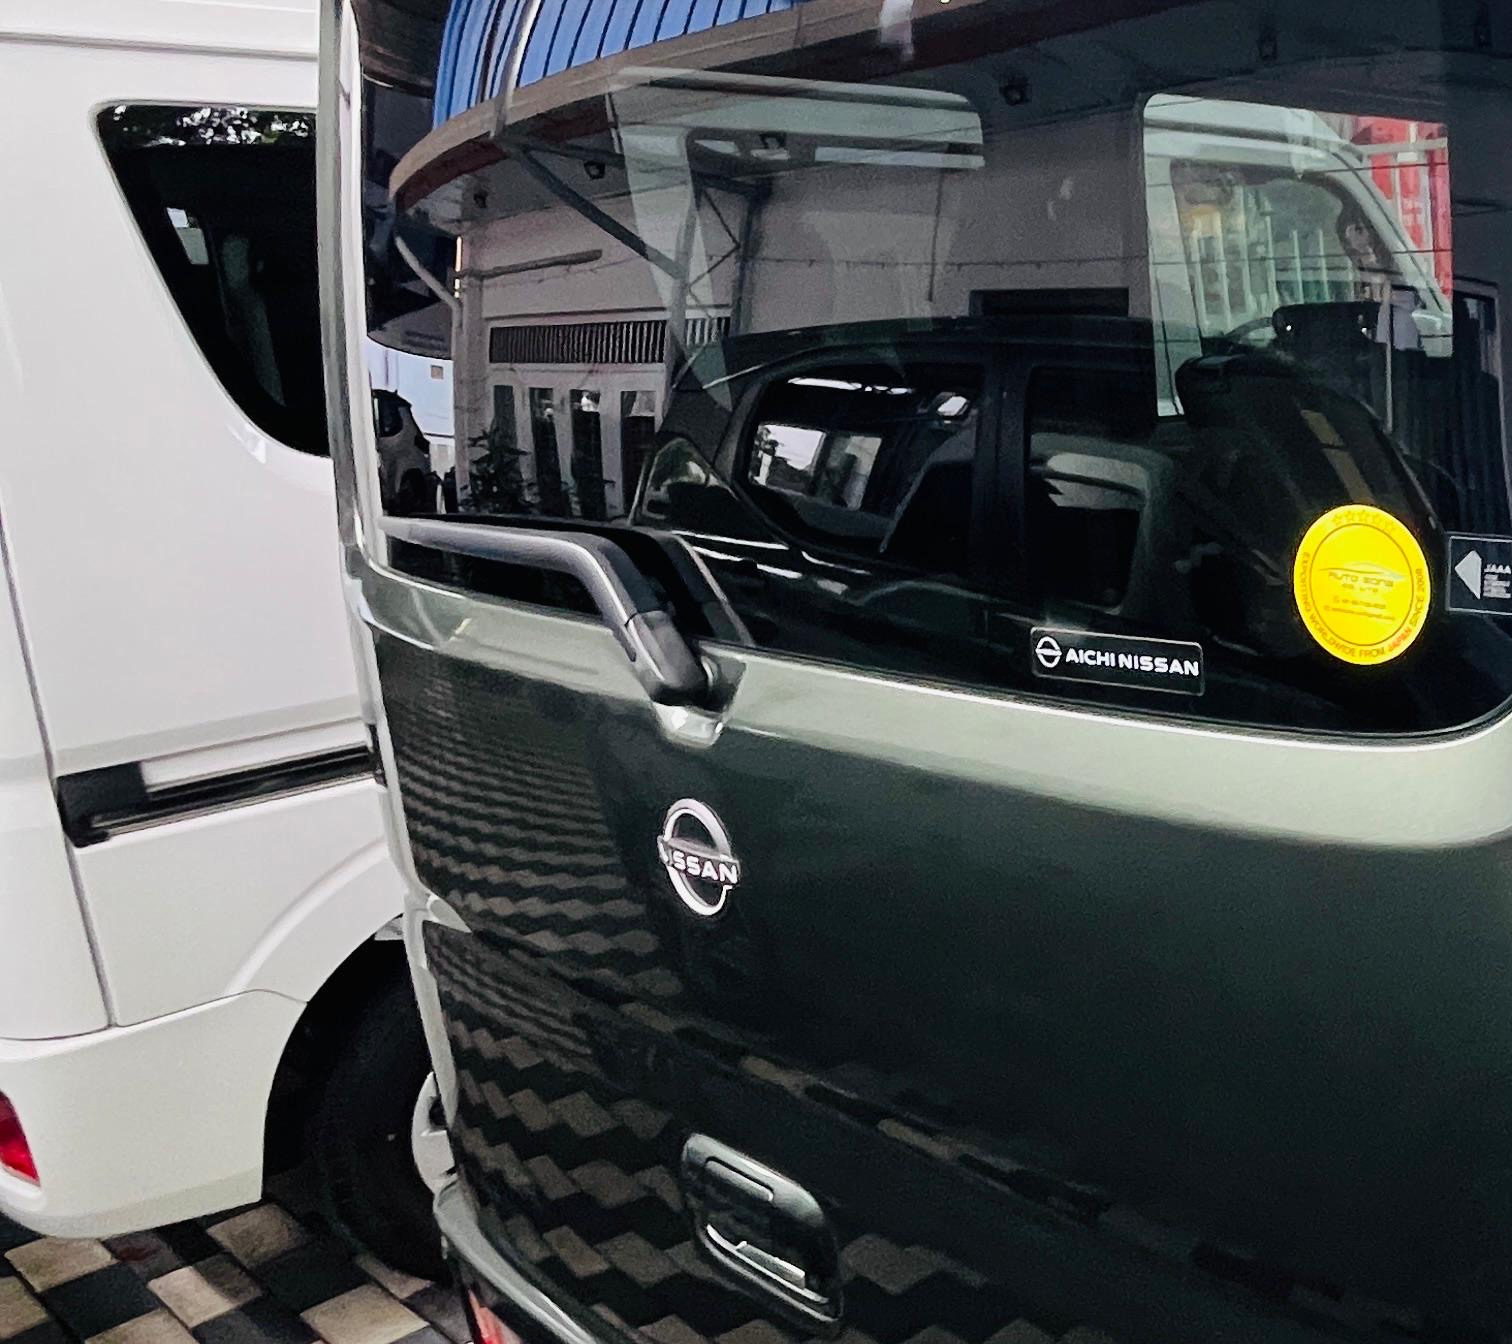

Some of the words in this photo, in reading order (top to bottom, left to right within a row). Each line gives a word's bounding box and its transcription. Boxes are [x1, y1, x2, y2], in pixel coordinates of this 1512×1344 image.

[1300, 552, 1311, 613] EXPORTING
[1310, 614, 1356, 657] WORLDWIDE
[1359, 647, 1385, 657] FROM
[1388, 627, 1412, 652] JAPAN
[1409, 598, 1425, 627] SINCE
[1065, 647, 1116, 667] AICHI
[1118, 653, 1199, 677] NISSAN
